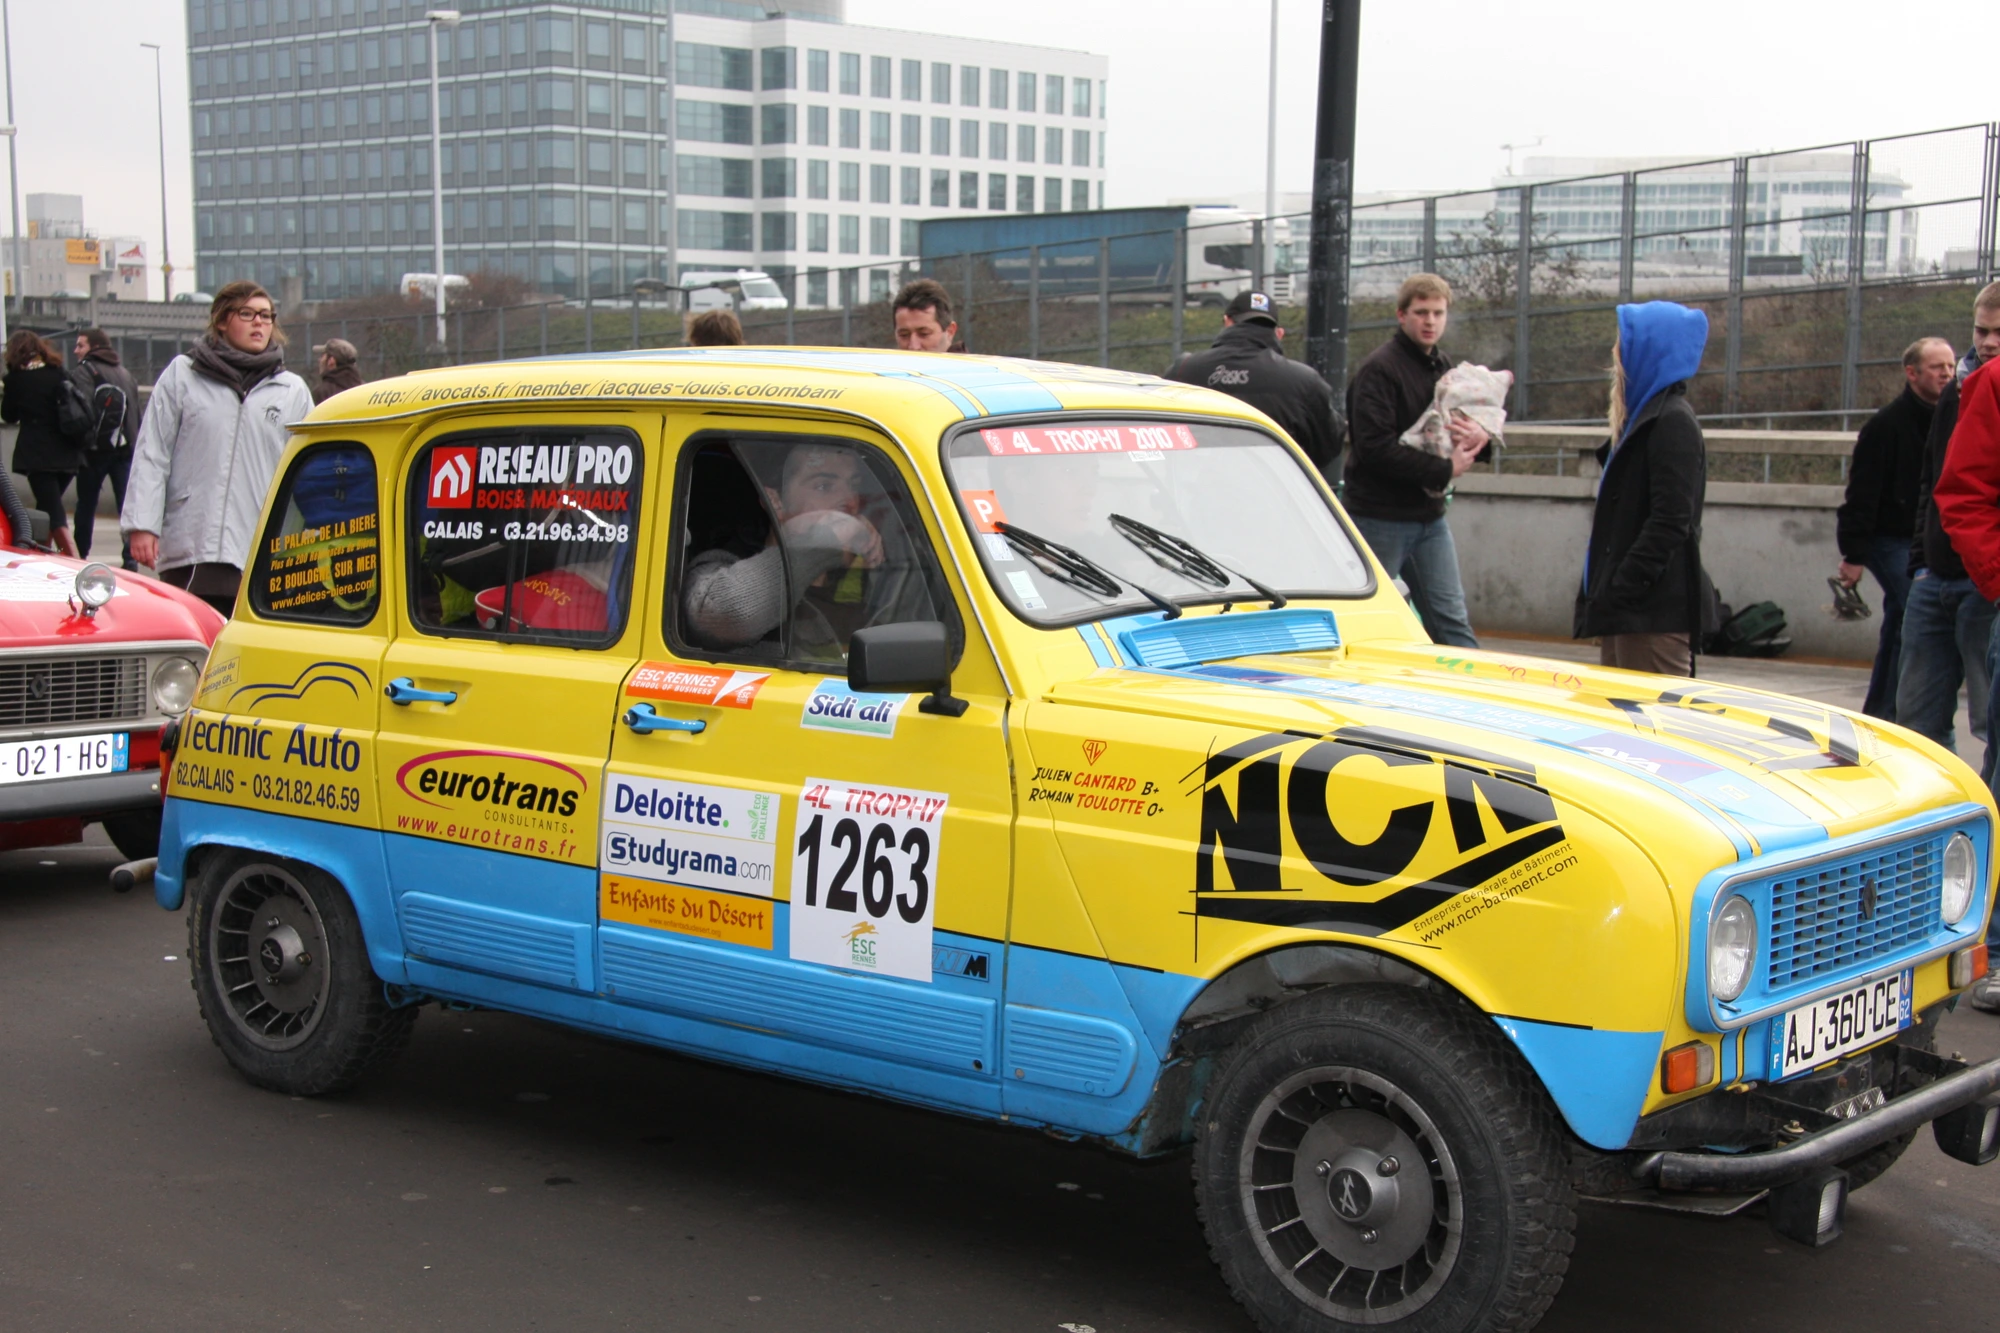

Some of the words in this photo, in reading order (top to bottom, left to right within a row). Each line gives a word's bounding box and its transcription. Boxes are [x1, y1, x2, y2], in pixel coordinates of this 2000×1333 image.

[1012, 431, 1042, 453] 4L
[1043, 429, 1123, 452] TROPHY
[1129, 427, 1174, 450] 2010
[576, 445, 633, 485] PRO
[973, 499, 993, 522] P
[271, 538, 280, 553] LE
[284, 529, 316, 550] PALAIS
[319, 525, 331, 541] DE
[335, 521, 346, 538] LA
[350, 513, 376, 534] BIERE
[423, 521, 483, 540] CALAIS
[269, 576, 282, 593] 62
[285, 566, 331, 590] BOULOGNE
[335, 560, 353, 578] SUR
[357, 554, 376, 573] MER
[630, 680, 659, 690] SCHOOL
[662, 683, 672, 691] OF
[674, 685, 712, 695] BUSINESS
[636, 668, 664, 681] ESC
[663, 672, 720, 687] RENNES
[808, 694, 857, 719] Sidi
[859, 700, 893, 723] ali
[183, 709, 273, 760] Technic
[283, 724, 360, 772] Auto
[177, 761, 234, 794] 62.CALAIS
[253, 773, 360, 812] 03.21.82.46.59
[419, 768, 579, 817] eurotrans
[1031, 767, 1072, 782] JULIEN
[1073, 772, 1137, 792] CANTARD
[758, 795, 770, 840] CHALLENGE
[804, 784, 832, 810] 4L
[845, 788, 946, 823] TROPHY
[1028, 788, 1074, 803] ROMAIN
[1076, 793, 1145, 815] TOULOTTE
[397, 814, 576, 858] www.eurotrans.fr
[798, 814, 930, 924] 1263
[1413, 900, 1462, 932] Entreprise
[1510, 868, 1523, 880] de
[1524, 843, 1573, 872] Bâtiment
[609, 882, 675, 915] Enfants
[681, 898, 703, 919] du
[708, 900, 764, 930] Désert
[1420, 855, 1578, 942] www.ncn-batiment.com
[852, 938, 876, 956] ESC
[852, 953, 876, 965] RENNES
[1785, 976, 1899, 1067] AJ-360-CE
[1898, 998, 1910, 1020] 62
[1773, 1053, 1780, 1070] F
